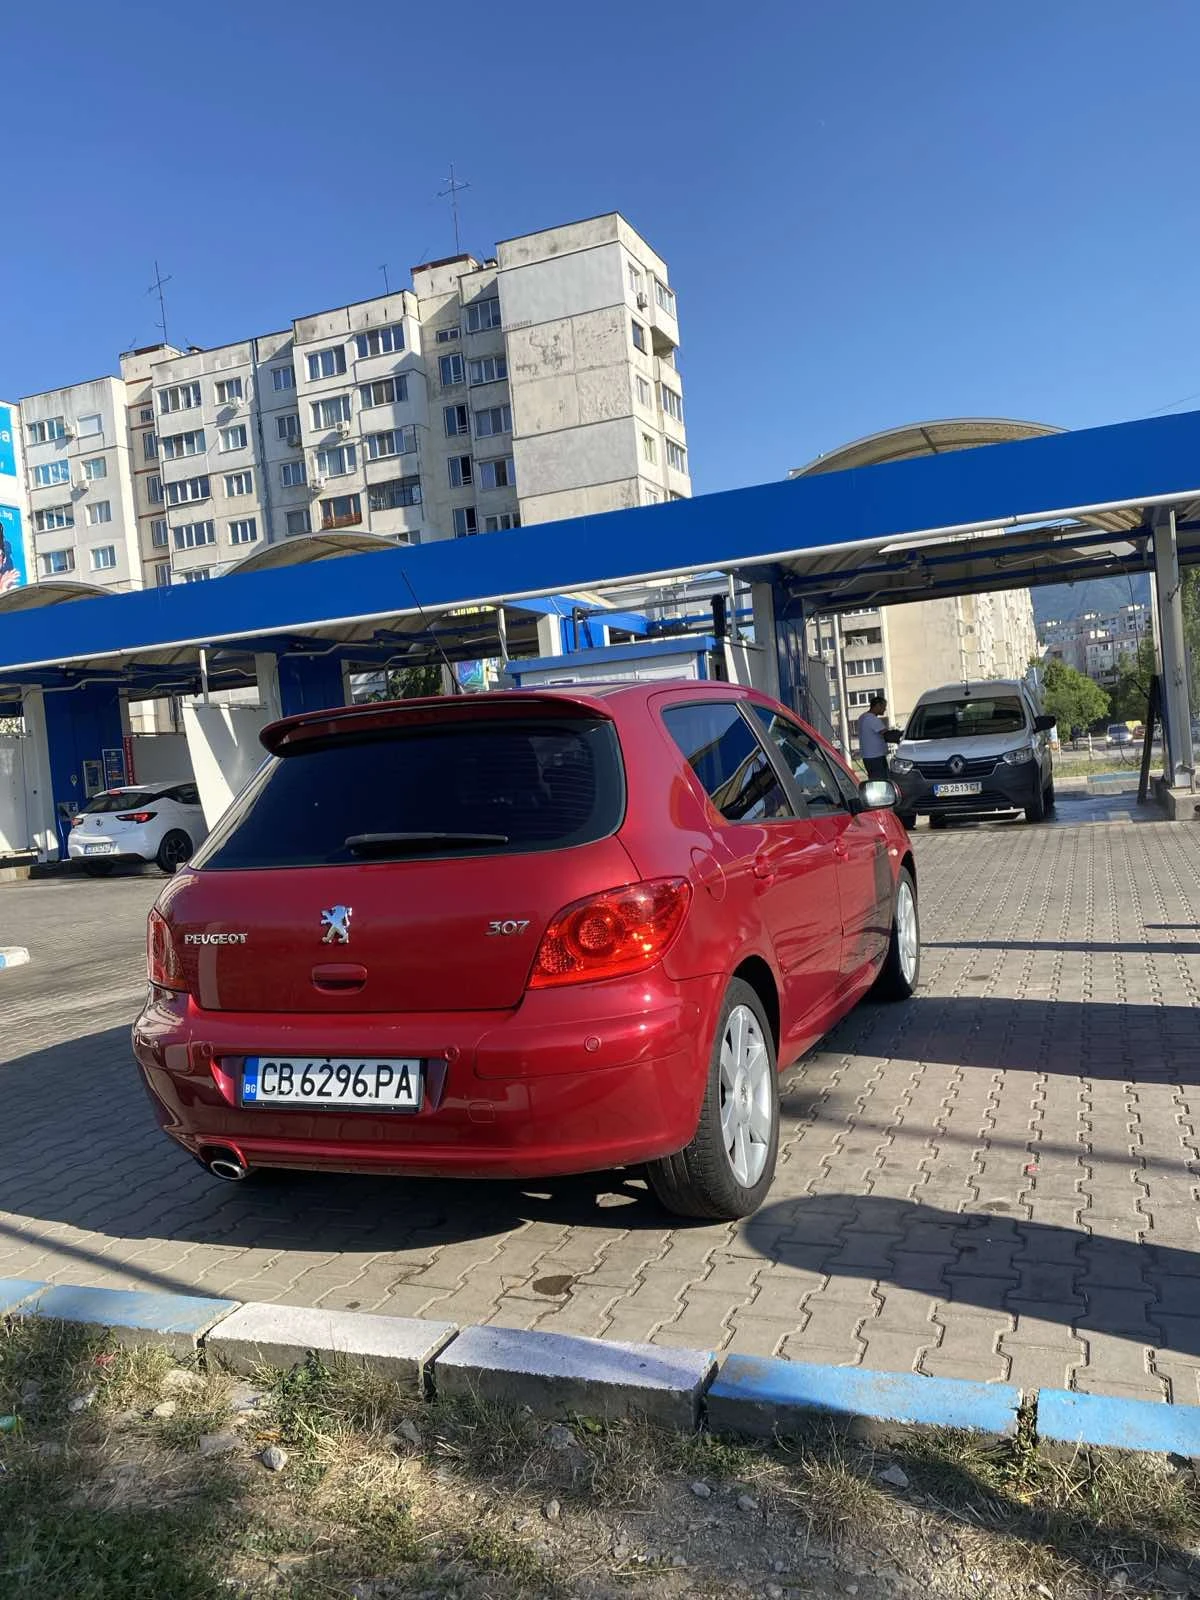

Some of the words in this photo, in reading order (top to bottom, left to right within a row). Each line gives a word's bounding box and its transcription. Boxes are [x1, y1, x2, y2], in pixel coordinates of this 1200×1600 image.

[484, 920, 530, 936] 307
[184, 933, 248, 944] PEUGEOT
[245, 1084, 257, 1094] BG
